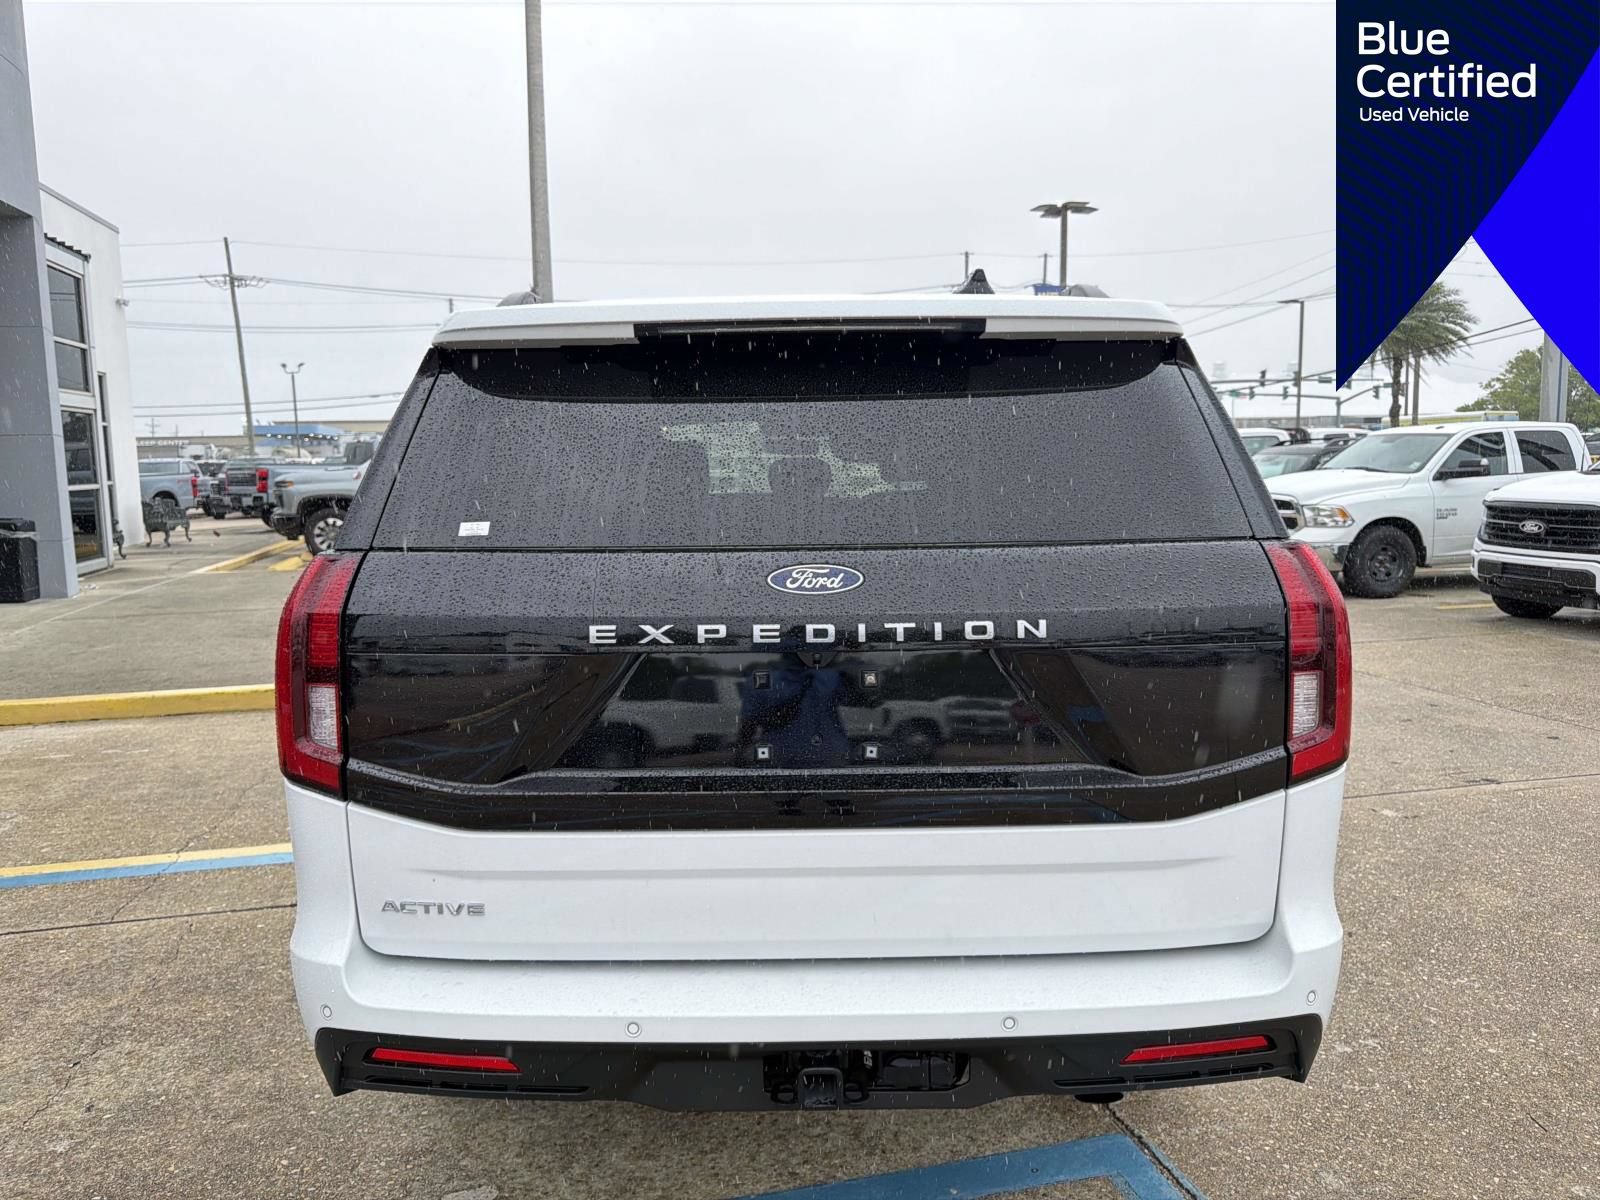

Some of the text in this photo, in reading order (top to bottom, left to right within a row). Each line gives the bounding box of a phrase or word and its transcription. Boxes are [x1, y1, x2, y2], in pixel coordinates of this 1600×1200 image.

[786, 568, 844, 588] Ford
[588, 618, 1048, 645] EXPEDITION
[381, 899, 486, 916] ACTIVE
